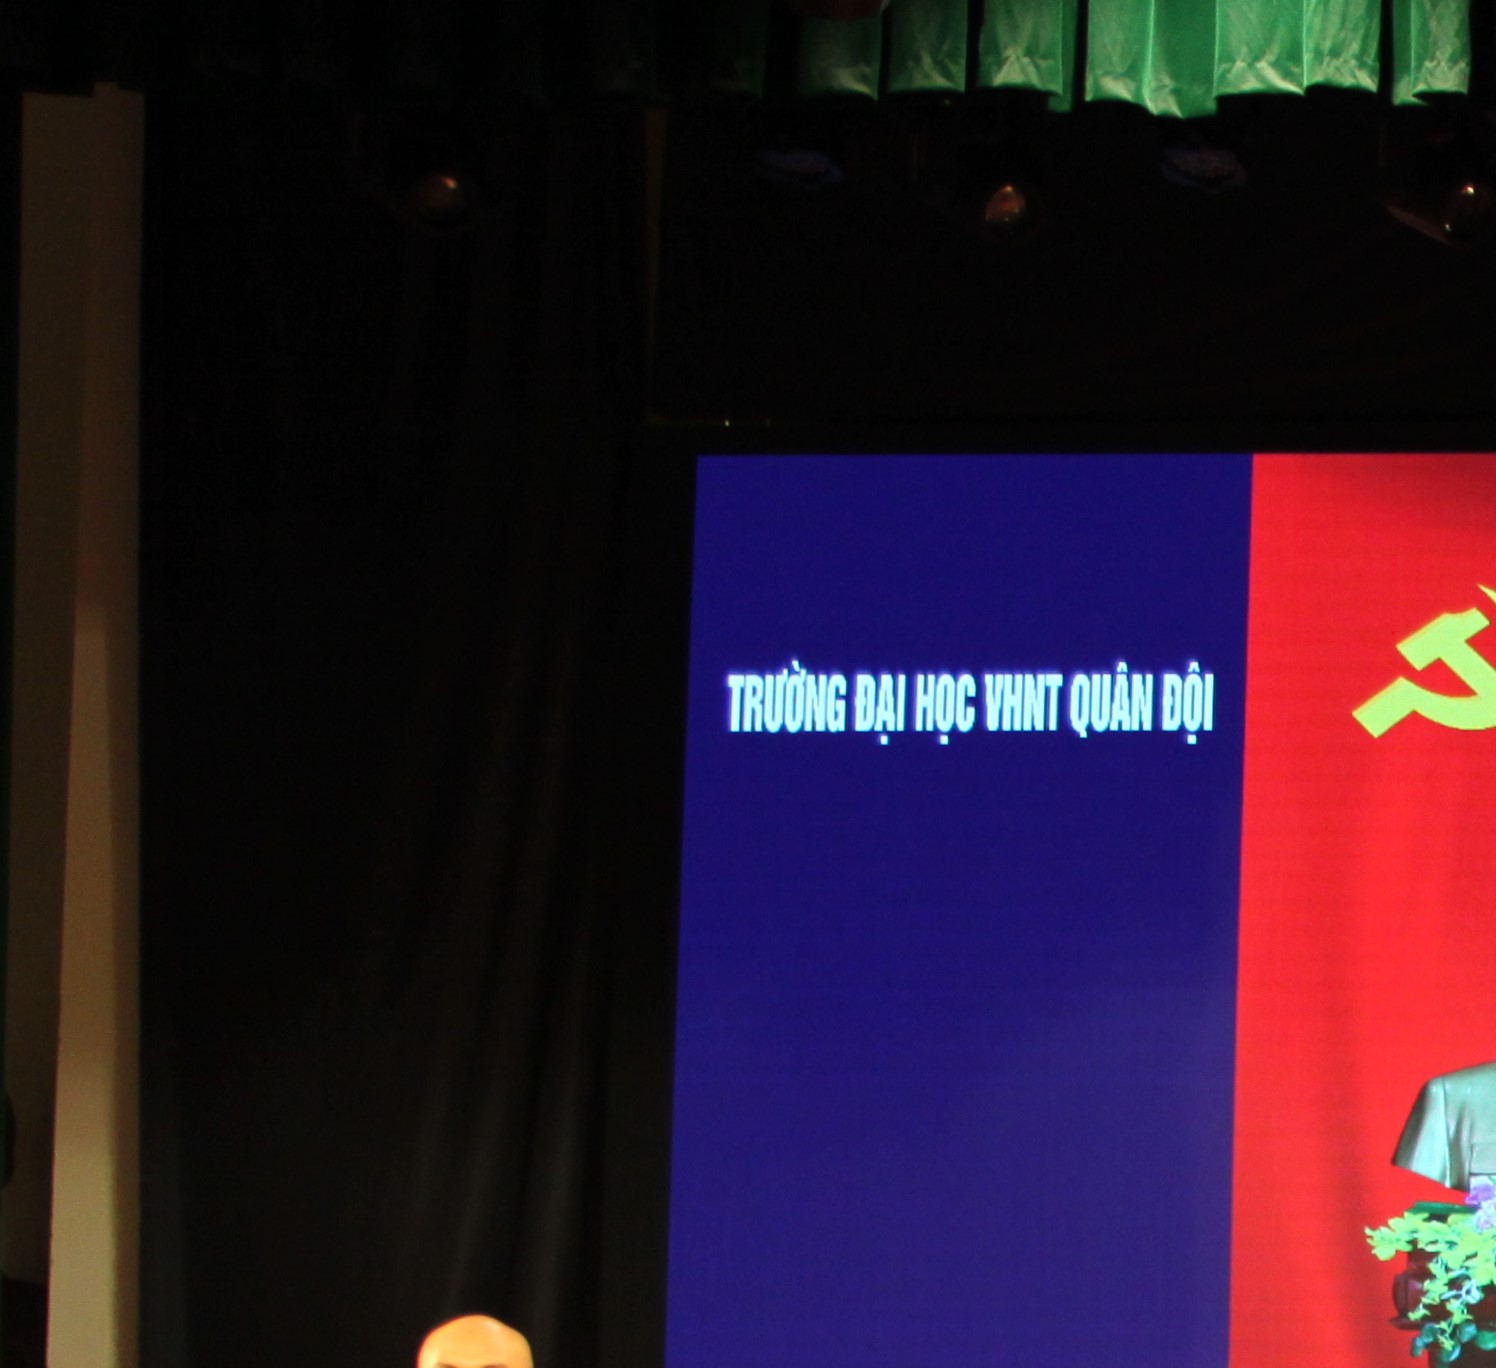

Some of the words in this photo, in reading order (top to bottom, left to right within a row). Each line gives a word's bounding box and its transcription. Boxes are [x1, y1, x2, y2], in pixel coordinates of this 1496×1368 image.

[727, 659, 847, 734] TRƯỜNG
[853, 673, 907, 746] ĐẠI
[914, 673, 977, 745] HỌC
[984, 673, 1064, 732] VHNT
[1069, 661, 1154, 739] QUÂN
[1161, 661, 1215, 745] ĐỘI
